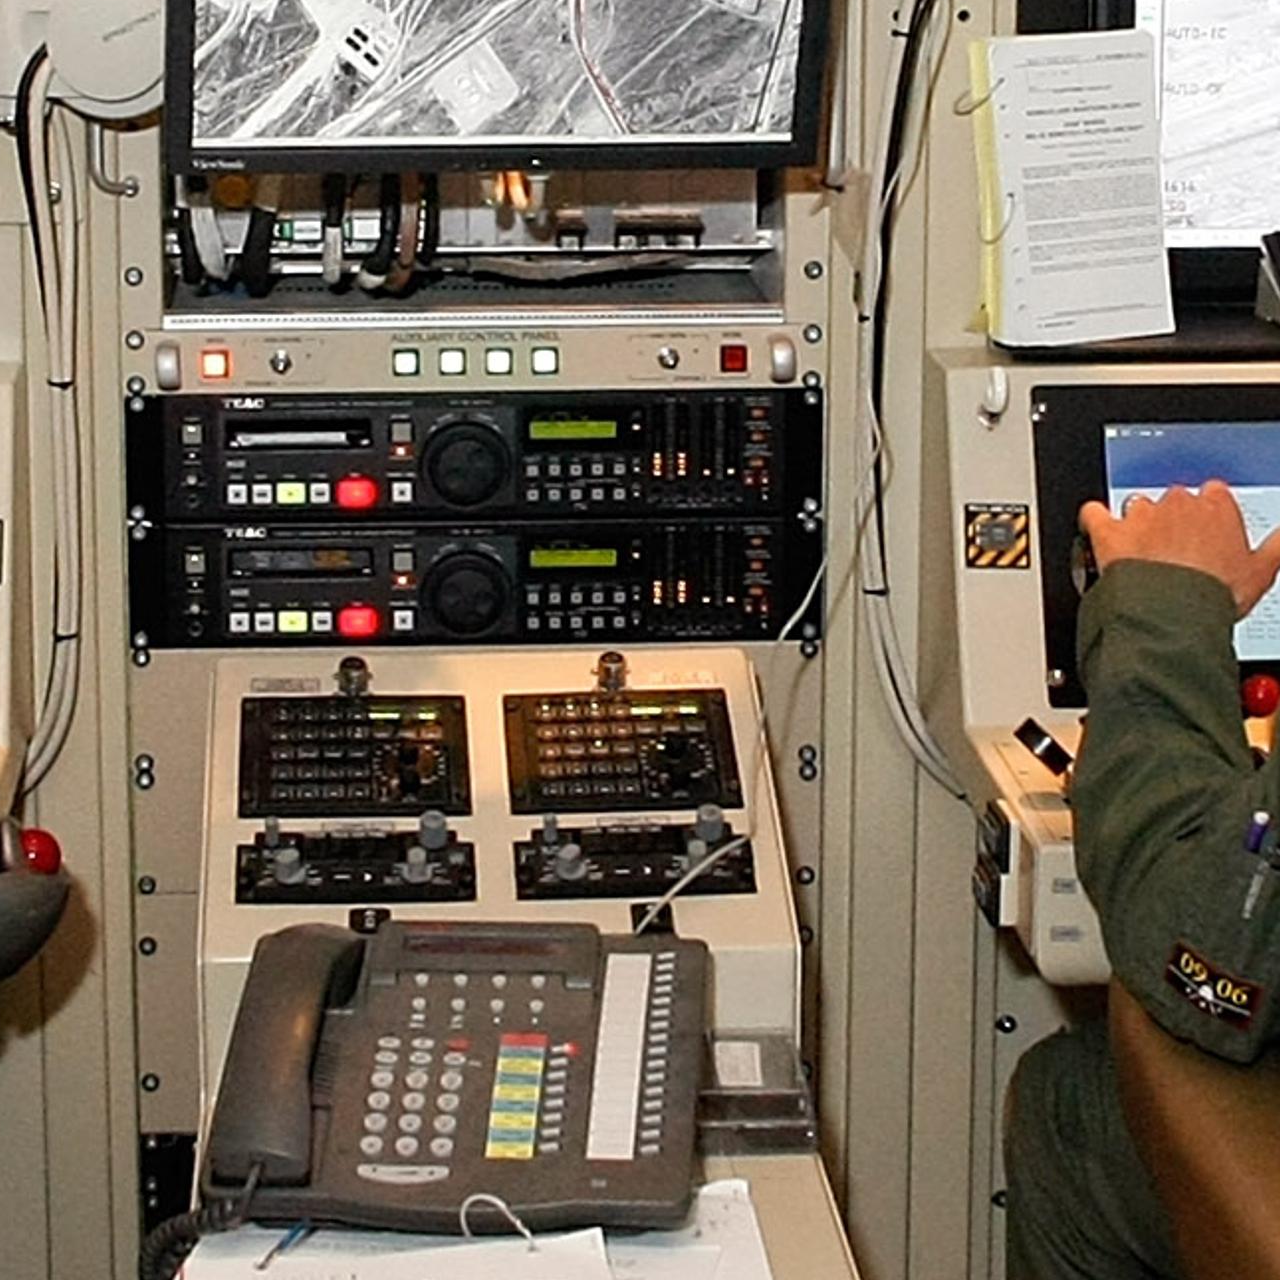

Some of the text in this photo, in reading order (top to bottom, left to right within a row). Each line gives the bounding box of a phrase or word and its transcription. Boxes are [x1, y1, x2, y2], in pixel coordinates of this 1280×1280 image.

[391, 331, 561, 343] AUXILIARY CONTROL PANEL
[224, 398, 265, 409] TEAC
[224, 528, 267, 539] TEAC
[1180, 952, 1249, 1006] 09 06
